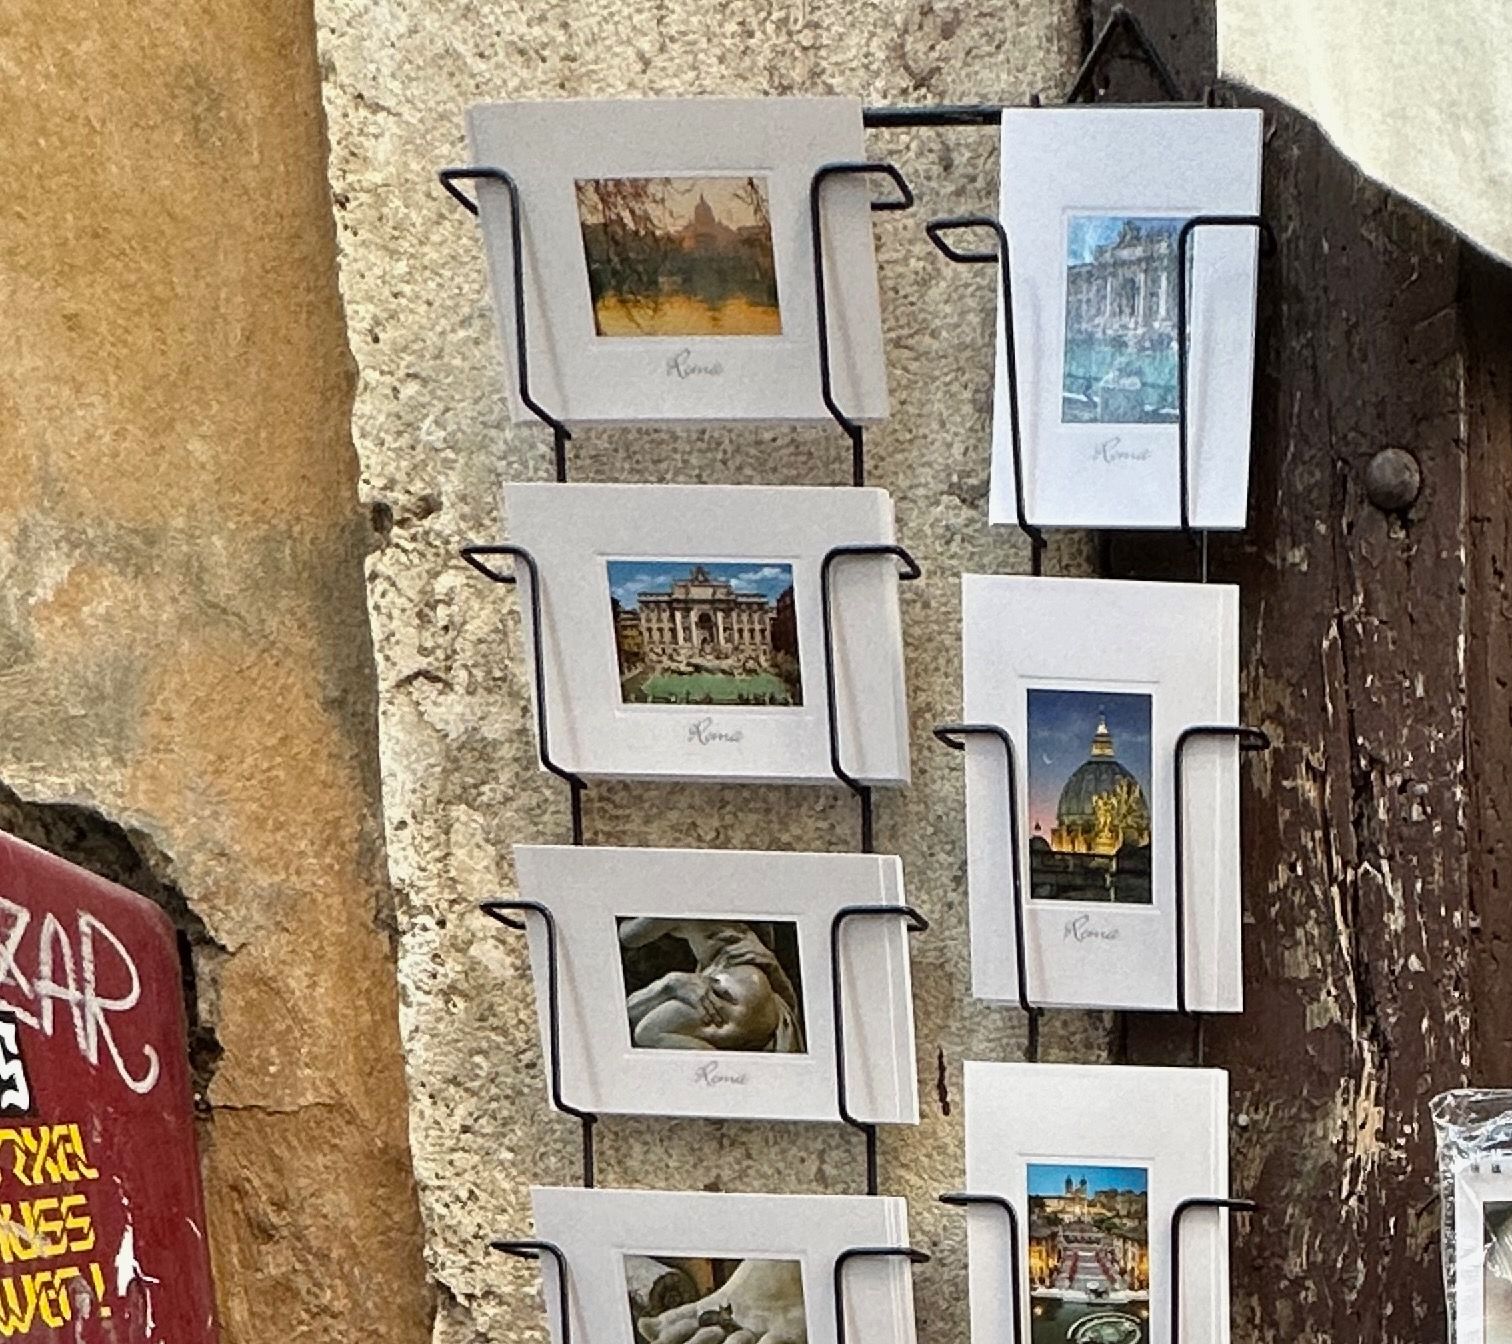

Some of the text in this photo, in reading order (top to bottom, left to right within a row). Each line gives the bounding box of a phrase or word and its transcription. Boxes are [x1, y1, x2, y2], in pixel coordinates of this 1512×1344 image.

[666, 348, 725, 379] Roma
[1093, 437, 1150, 465] Roma
[688, 717, 743, 746] Roma
[1064, 914, 1120, 943] Roma
[695, 1060, 748, 1088] Roma
